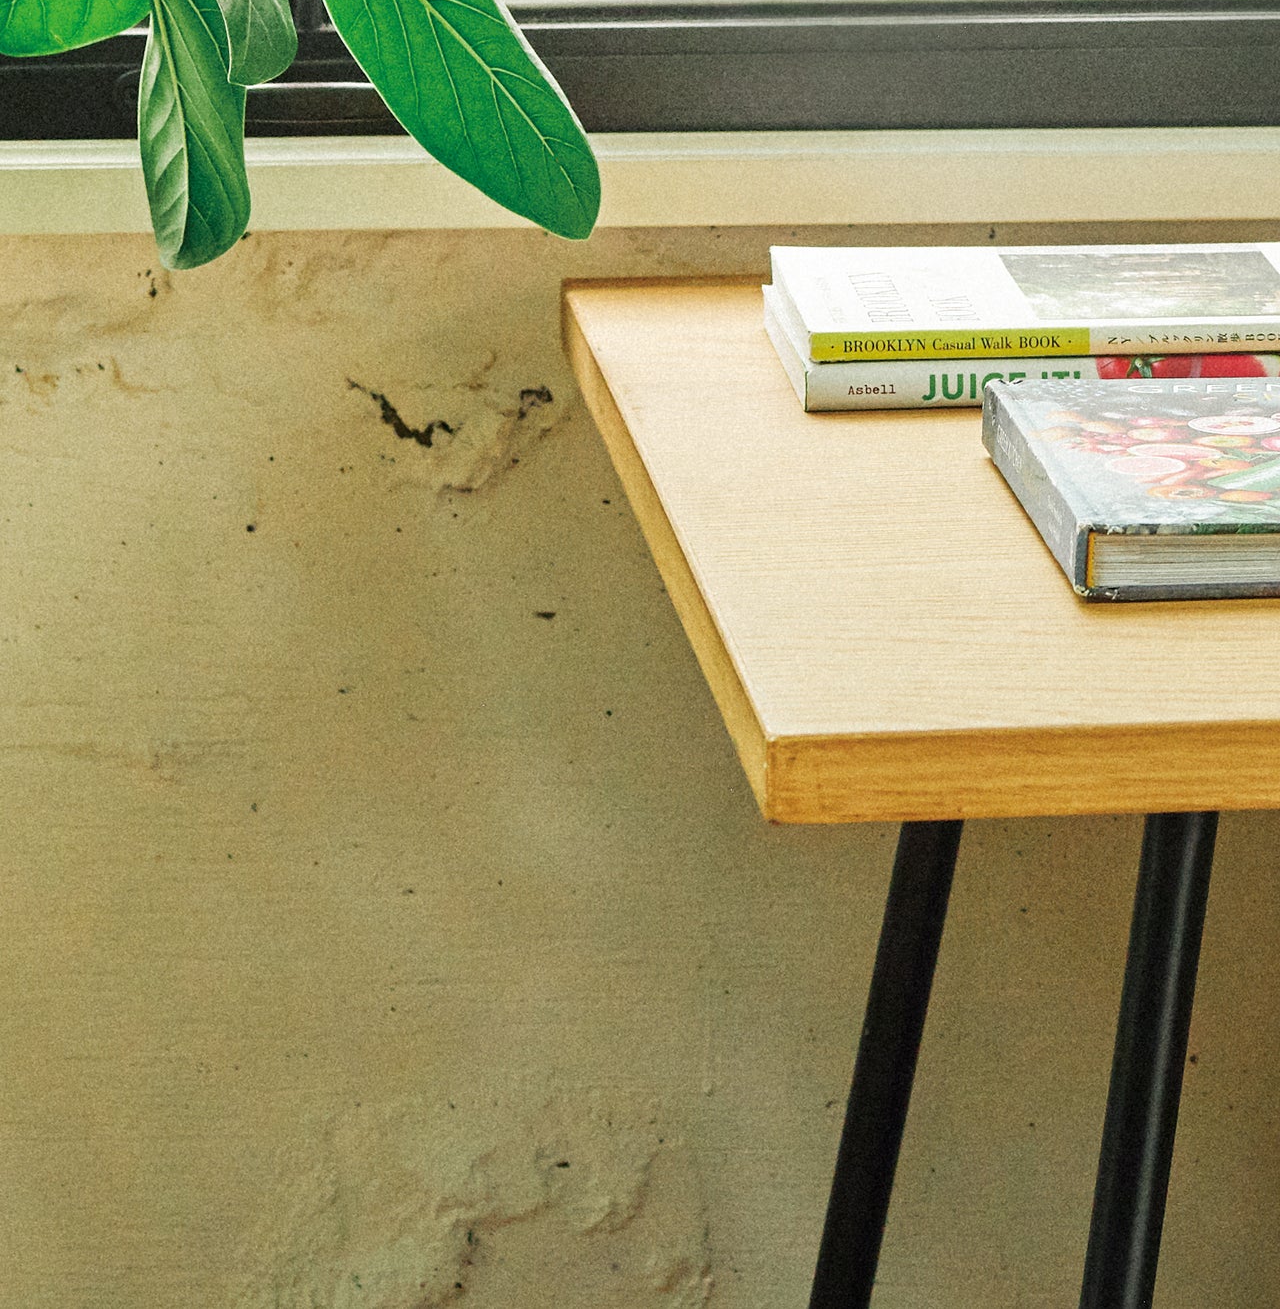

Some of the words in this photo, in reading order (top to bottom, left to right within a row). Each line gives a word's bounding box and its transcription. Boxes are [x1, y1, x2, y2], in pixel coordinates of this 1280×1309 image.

[843, 339, 926, 353] BROOKLYN
[932, 337, 976, 351] Casual
[981, 336, 1012, 350] Walk
[1019, 335, 1061, 348] BOOK
[847, 384, 896, 396] Asbell
